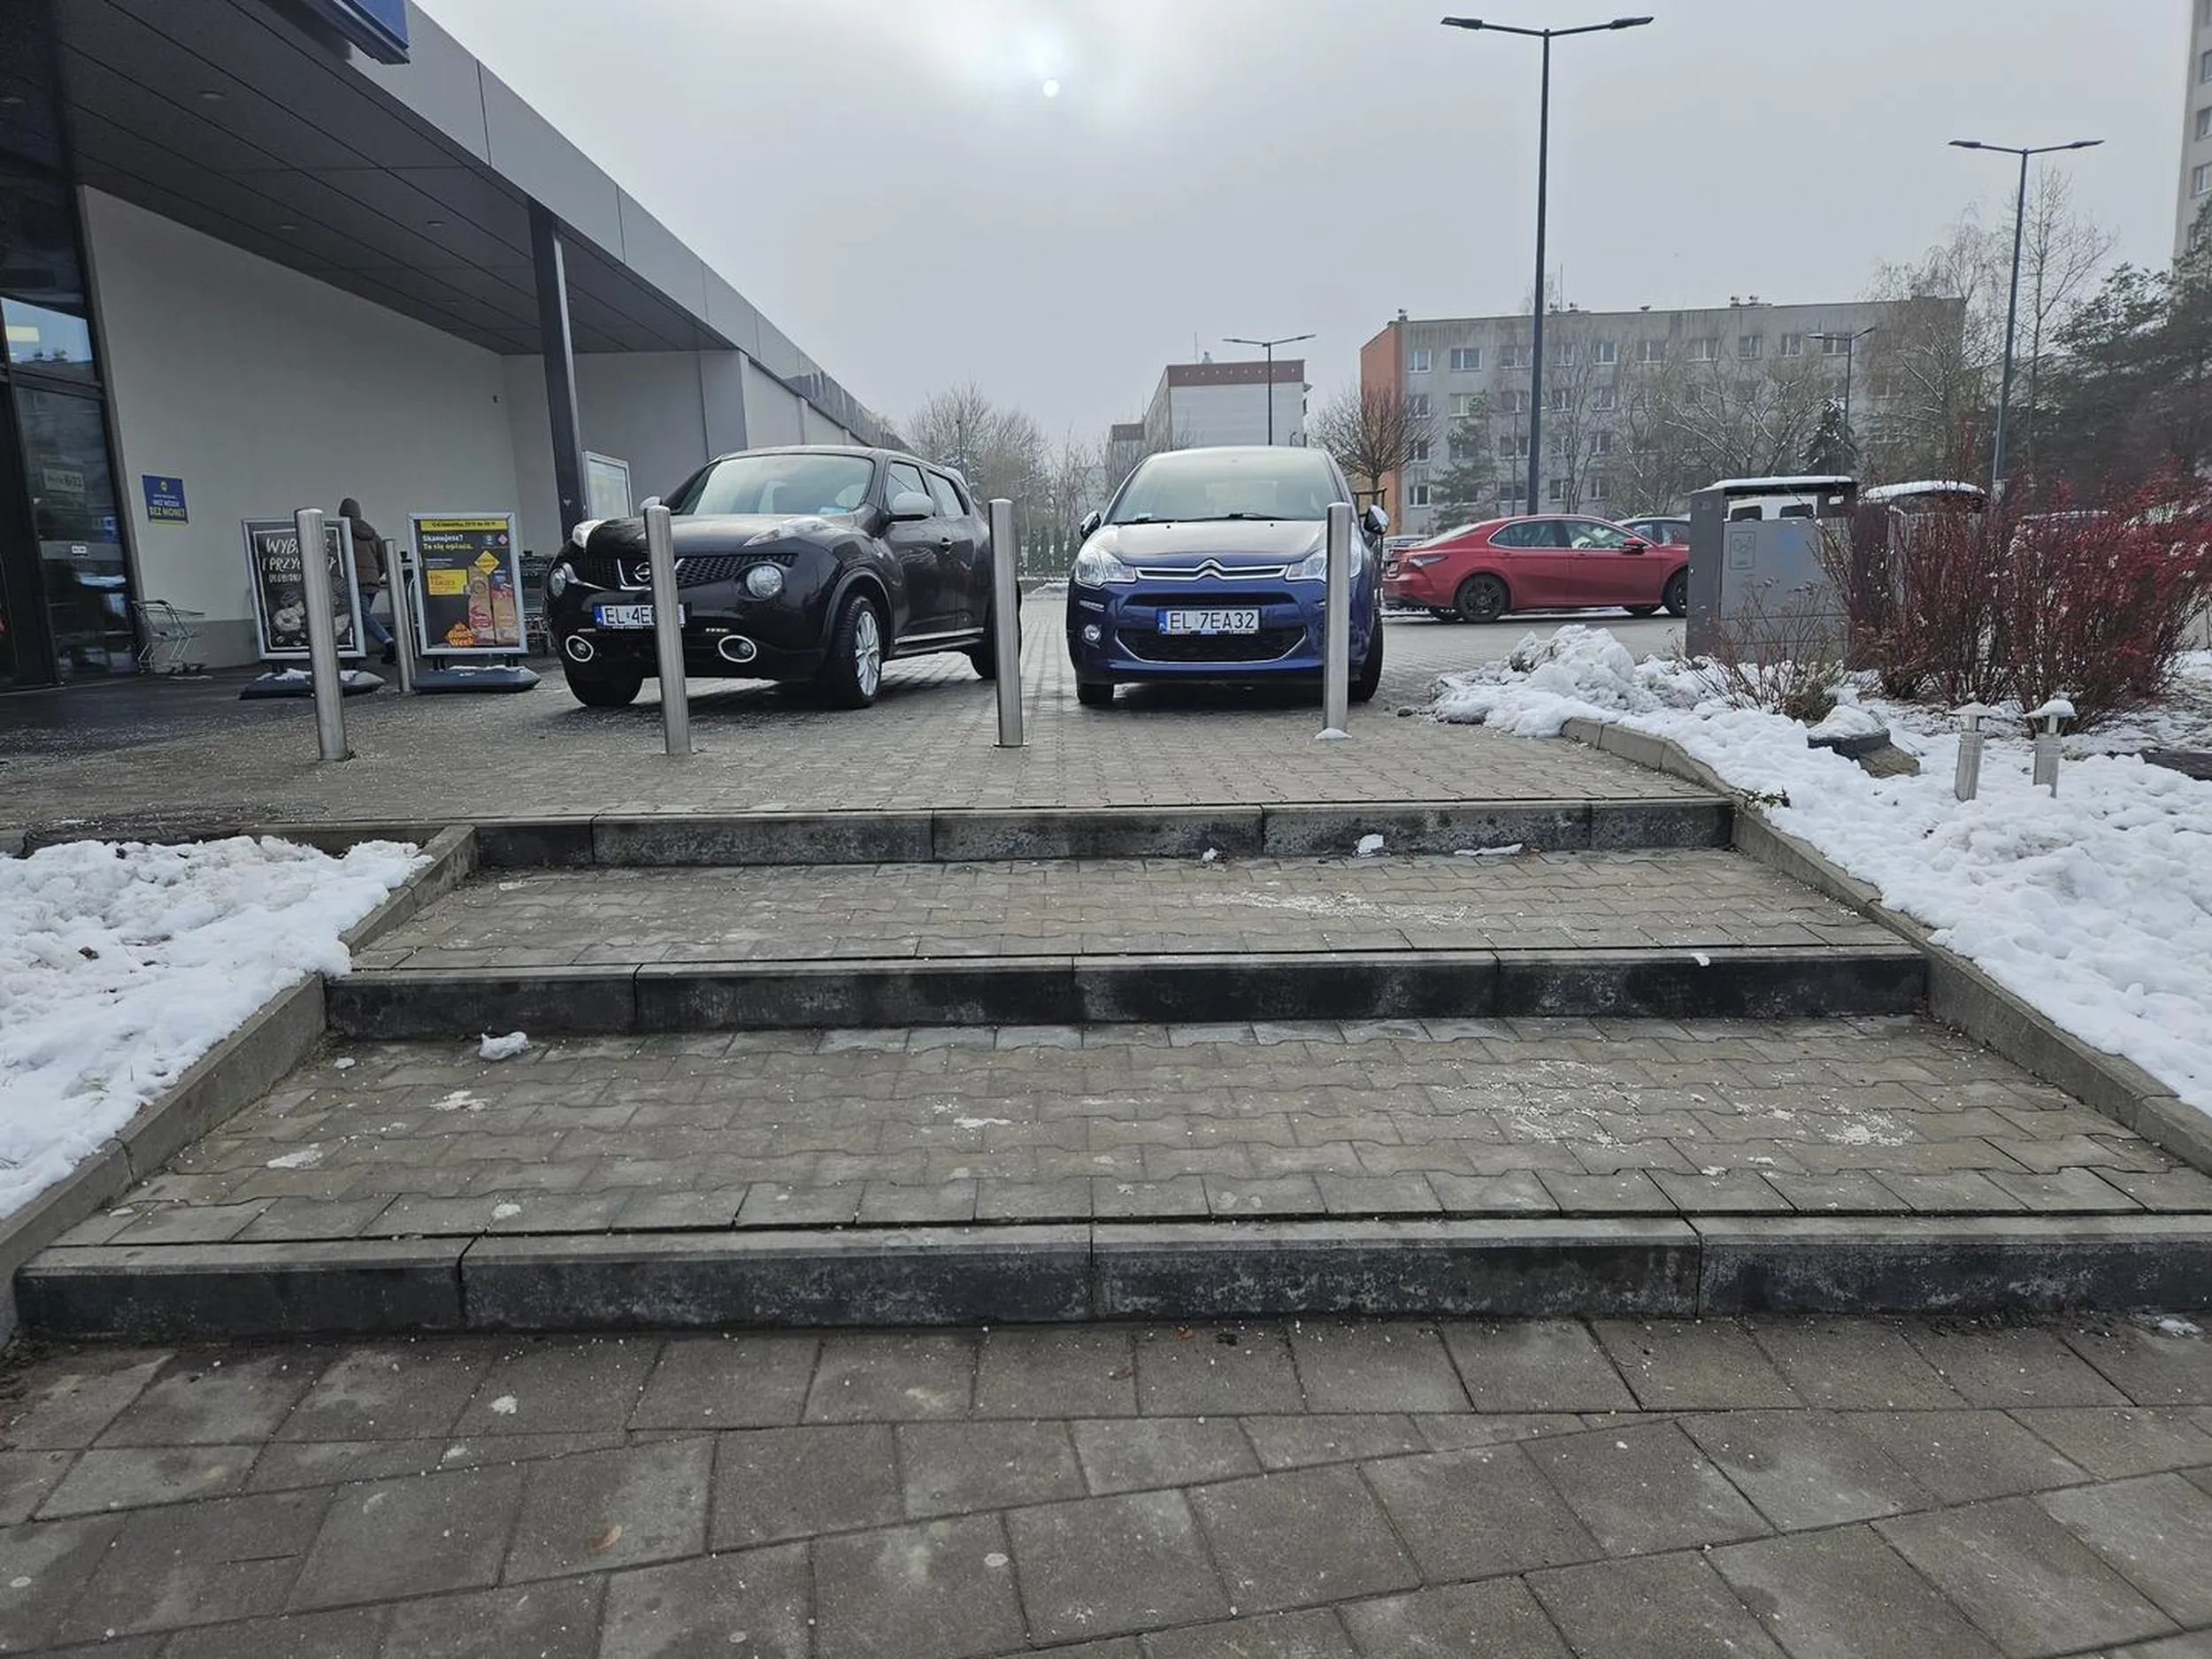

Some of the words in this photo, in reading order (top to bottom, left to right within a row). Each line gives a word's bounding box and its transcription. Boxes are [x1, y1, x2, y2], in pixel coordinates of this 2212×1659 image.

[605, 607, 625, 624] EL
[1170, 612, 1192, 629] EL
[1200, 612, 1255, 629] 7EA32
